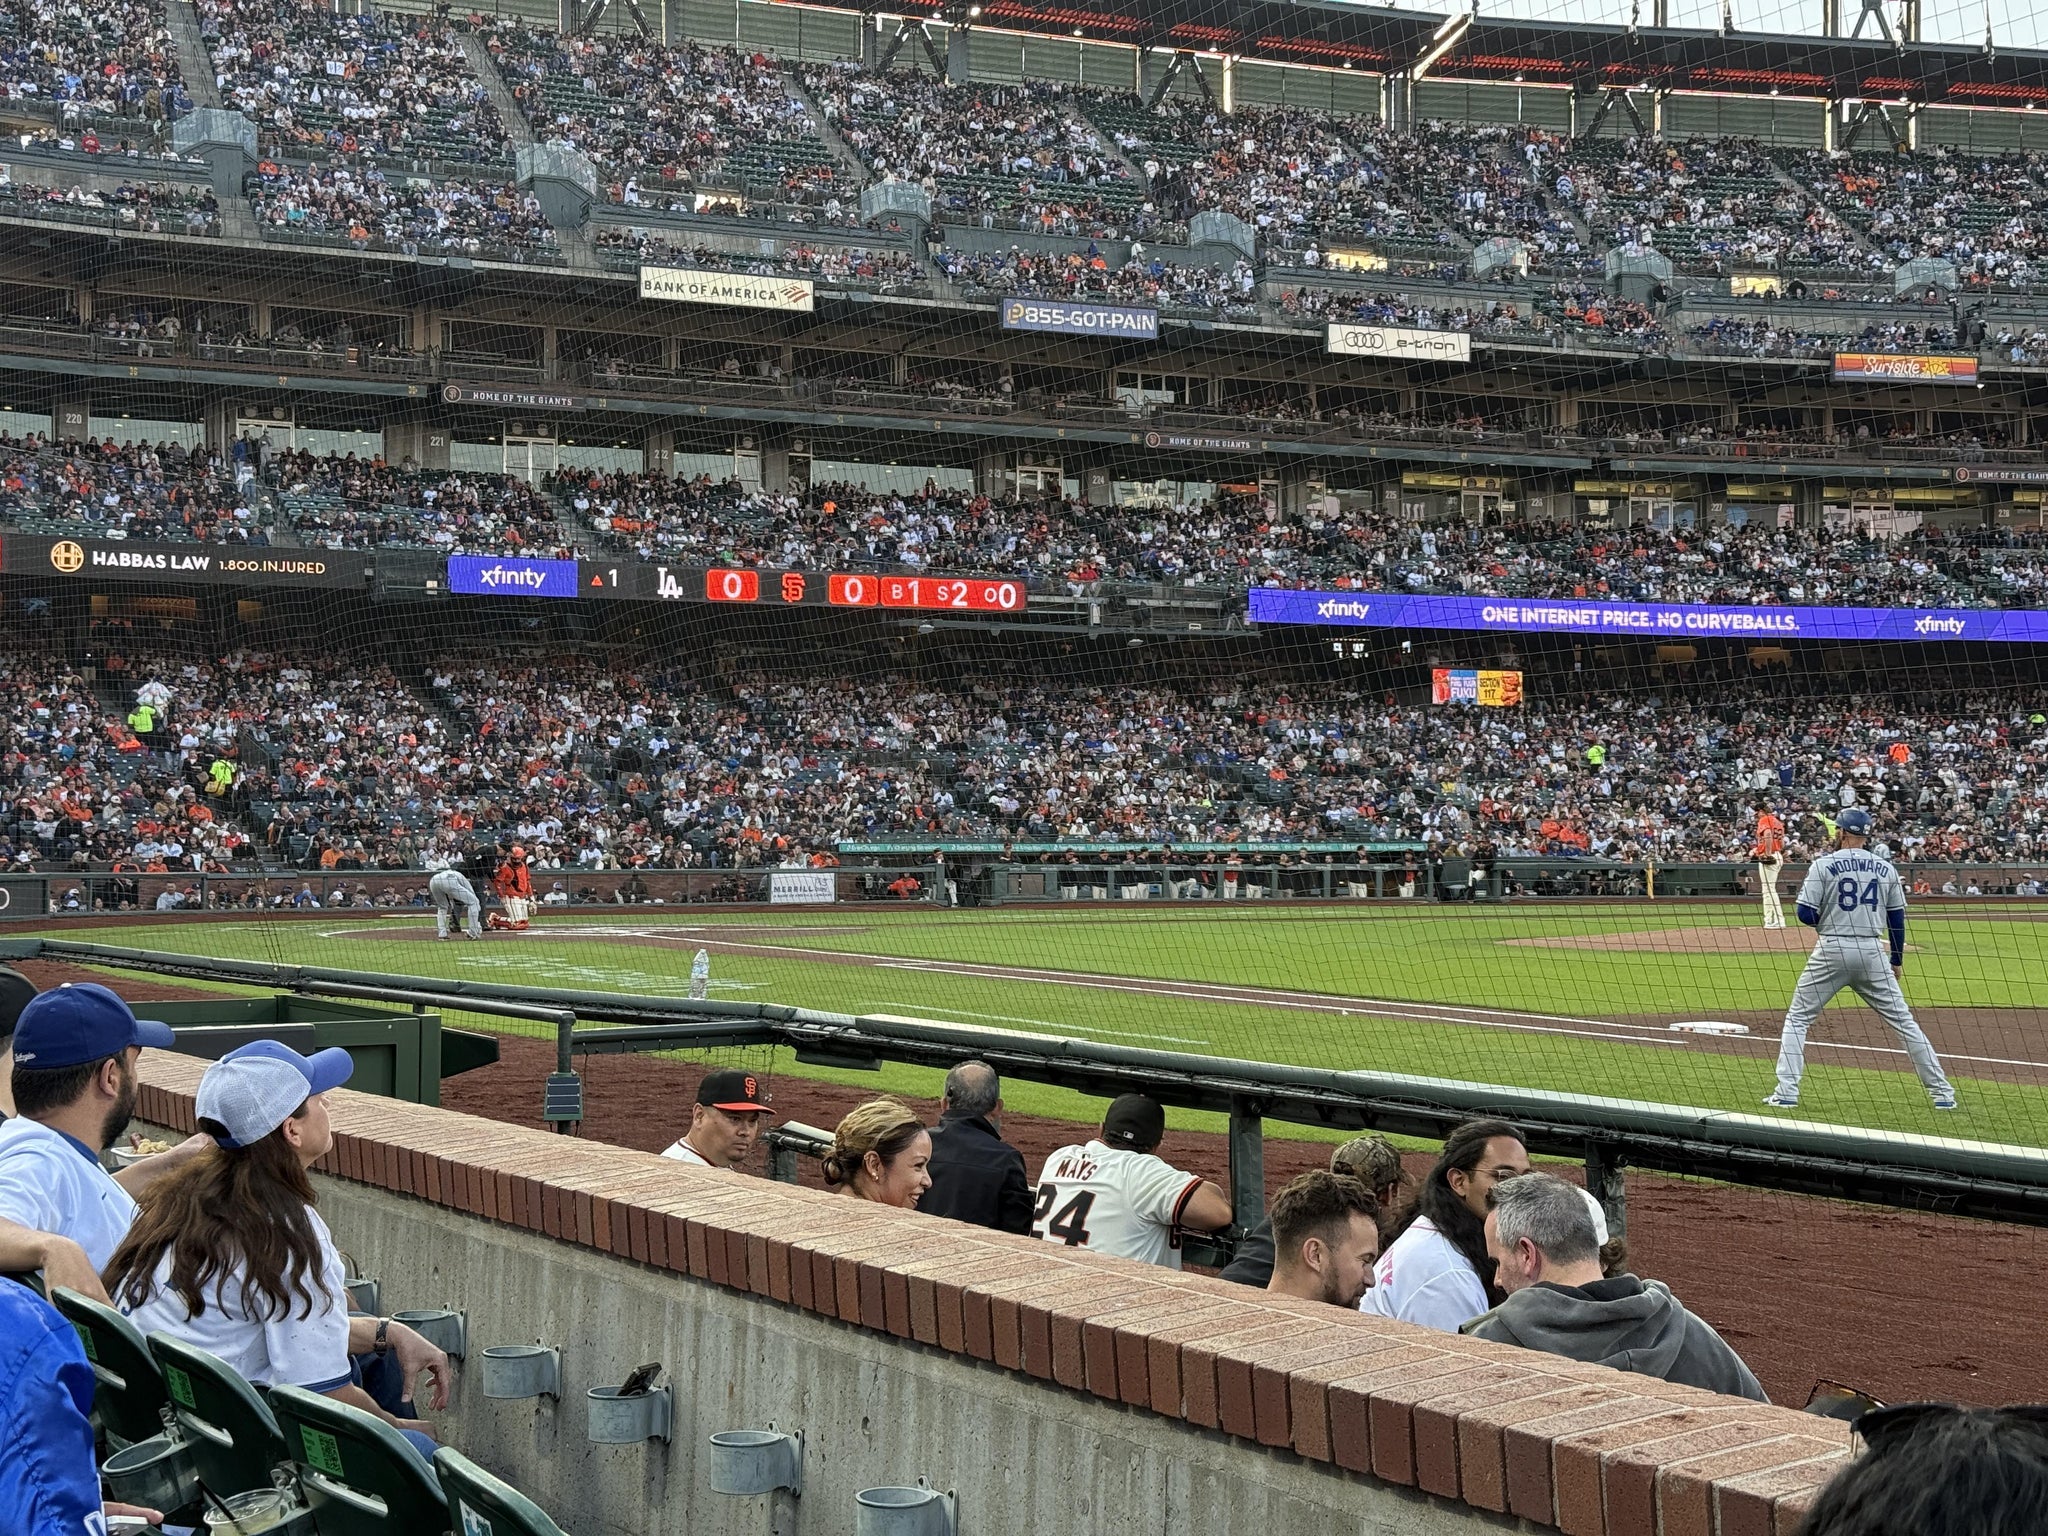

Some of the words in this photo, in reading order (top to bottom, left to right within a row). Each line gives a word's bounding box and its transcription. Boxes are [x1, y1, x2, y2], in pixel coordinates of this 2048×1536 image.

[644, 280, 685, 293] BANK
[688, 284, 707, 295] OF
[711, 286, 778, 301] AMERICA
[1025, 307, 1155, 330] 855-GOT-PAIN
[1396, 338, 1456, 351] e-tron
[1863, 355, 1920, 375] Surfside
[472, 391, 499, 401] HOME
[502, 393, 514, 402] OF
[516, 394, 535, 404] THE
[538, 396, 573, 406] GIANTS
[65, 413, 82, 424] 220
[430, 436, 444, 447] 221
[1169, 437, 1191, 446] HOME
[1193, 438, 1203, 447] OF
[1205, 439, 1220, 447] THE
[1222, 440, 1251, 449] GIANTS
[93, 550, 167, 569] HABBAS
[170, 555, 210, 571] LAW
[219, 560, 326, 575] 1.800.INJURED
[480, 565, 546, 588] xfinity
[608, 568, 618, 587] 1
[657, 567, 683, 599] LA
[722, 572, 742, 599] 0
[844, 577, 863, 603] 0
[1317, 599, 1369, 619] xfinity
[1482, 606, 1519, 623] ONE
[1521, 607, 1600, 626] INTERNET
[1603, 611, 1654, 627] PRICE.
[1657, 613, 1683, 628] NO
[1685, 613, 1800, 632] CURVEBALLS.
[1914, 616, 1966, 635] xfinity
[1451, 687, 1476, 698] FUKU
[1479, 678, 1500, 688] SECTION
[1484, 688, 1496, 699] 117
[1826, 858, 1889, 878] WOODWARD
[1837, 877, 1879, 912] 84
[1055, 1159, 1098, 1182] MAYS
[1030, 1183, 1097, 1247] 24
